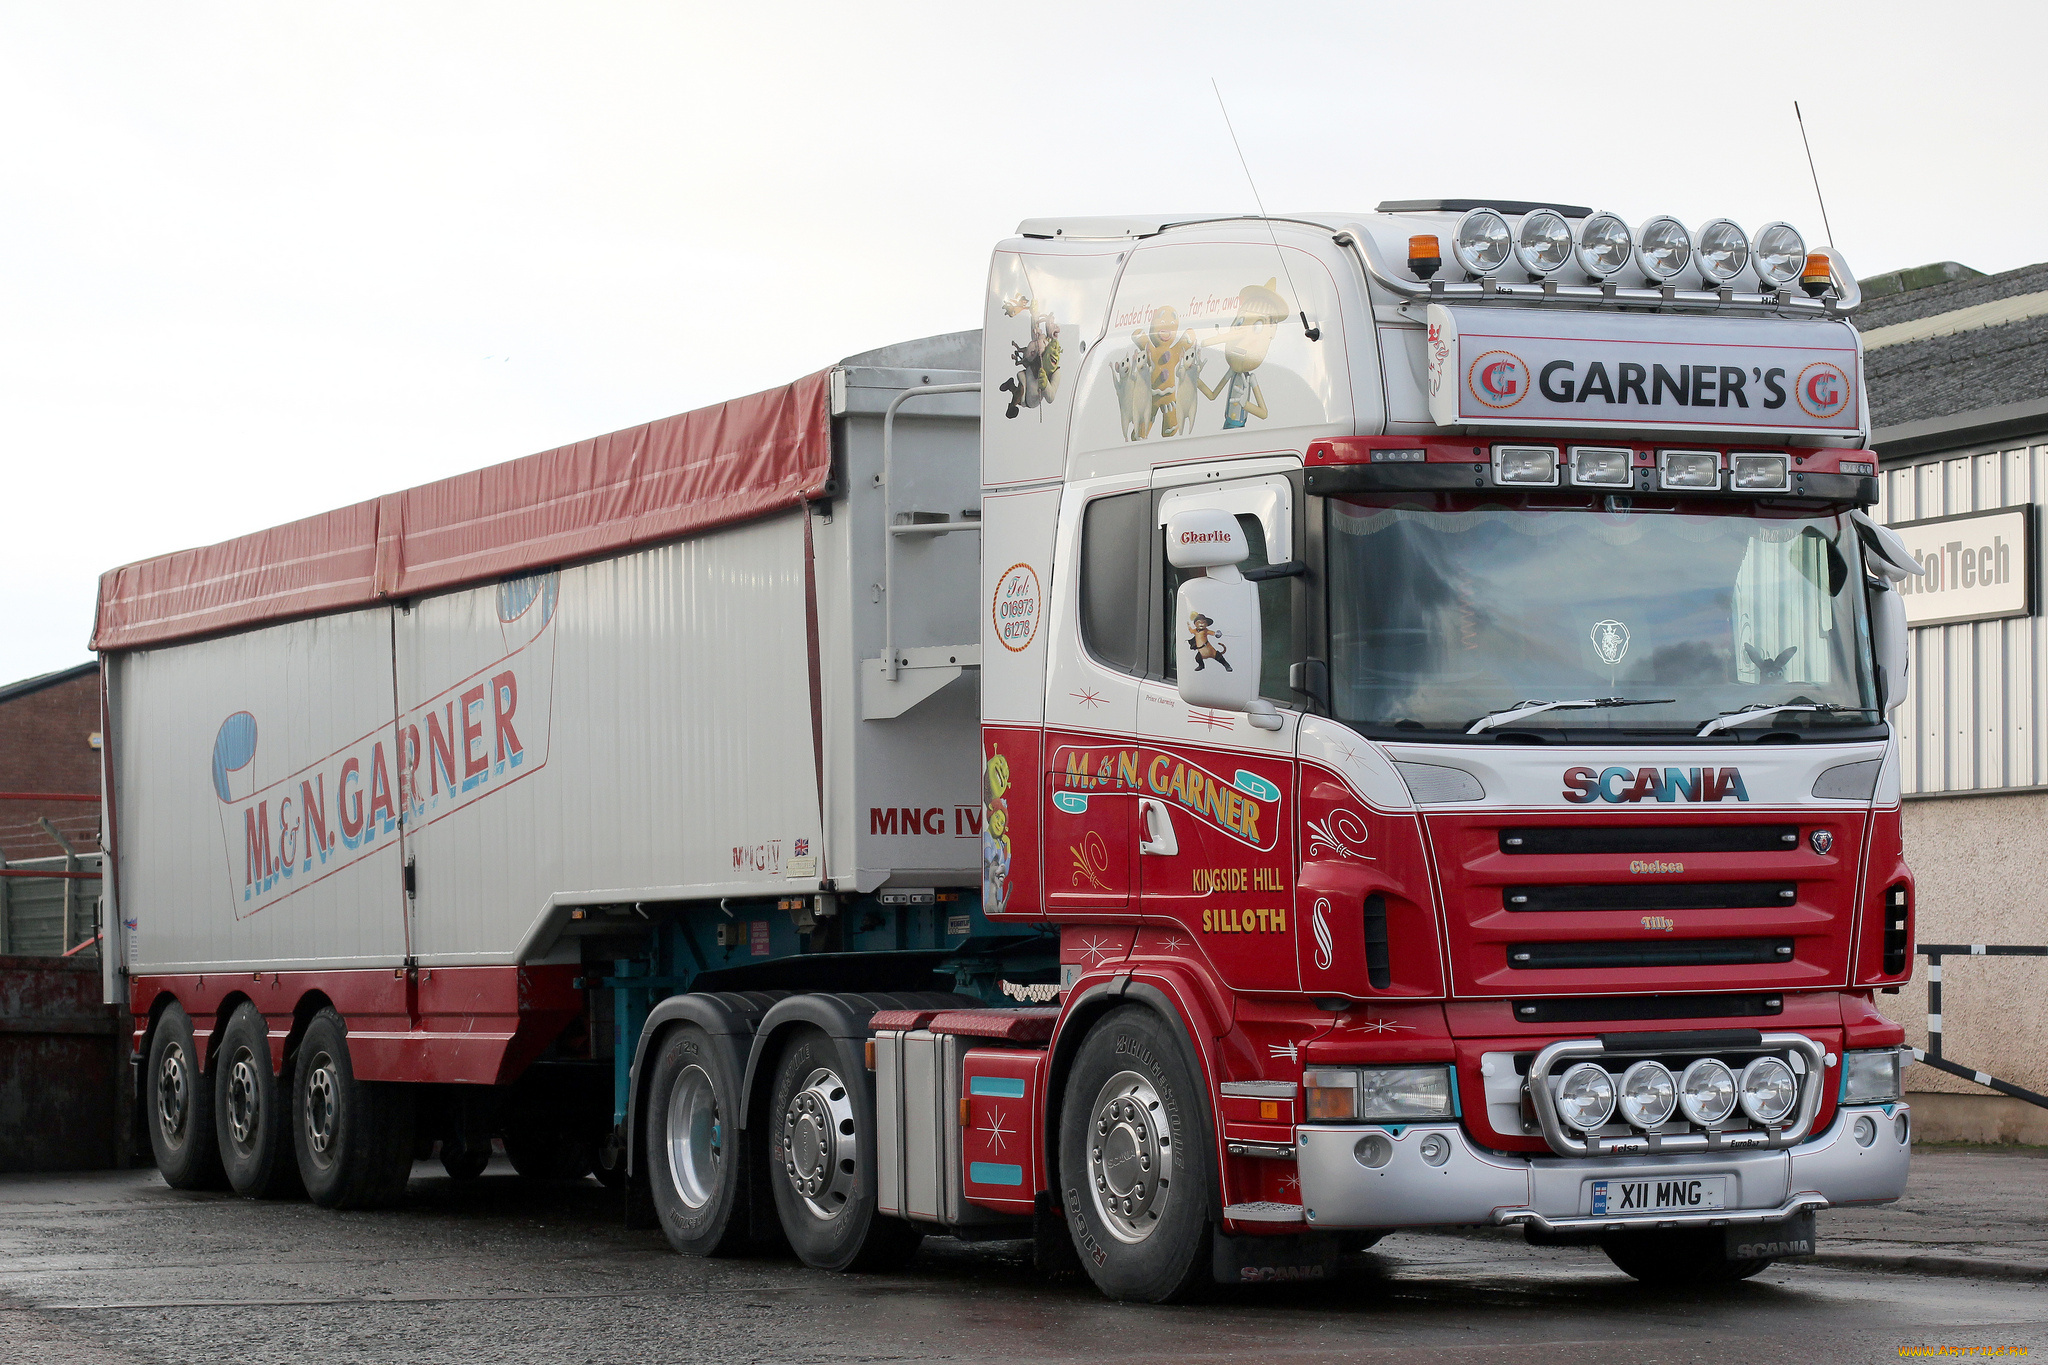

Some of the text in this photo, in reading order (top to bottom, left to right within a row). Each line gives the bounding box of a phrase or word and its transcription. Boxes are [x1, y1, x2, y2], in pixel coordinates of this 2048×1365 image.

[1115, 304, 1144, 328] Loaded
[1538, 359, 1787, 410] GARNER'S
[1180, 530, 1232, 545] Charlie
[1000, 598, 1034, 619] 016973
[1004, 620, 1031, 640] 61278
[338, 669, 524, 850] GARNER
[1562, 766, 1750, 804] SCANIA
[1148, 754, 1261, 844] GARNER
[870, 806, 982, 836] MNG IV
[1630, 860, 1684, 874] Chelsea
[1192, 867, 1284, 892] KINGSIDE HILL
[1203, 908, 1286, 934] SILLOTH
[1641, 916, 1673, 932] Tilly
[1656, 1181, 1701, 1207] MNG
[1737, 1240, 1810, 1259] SCANIA
[1240, 1265, 1324, 1283] SCANIA
